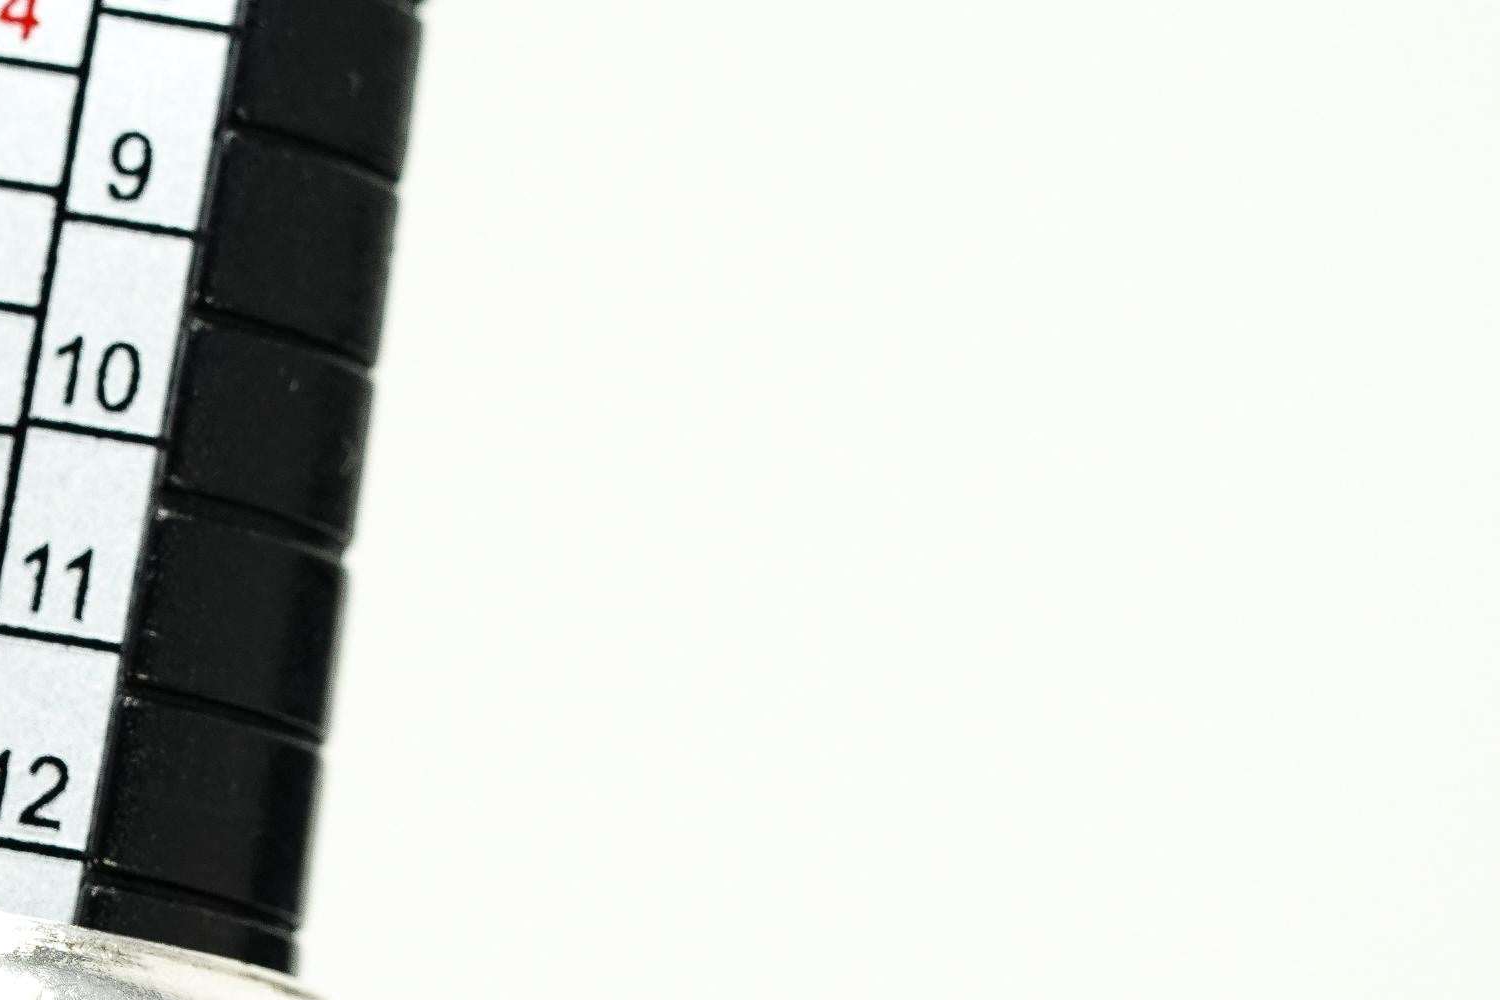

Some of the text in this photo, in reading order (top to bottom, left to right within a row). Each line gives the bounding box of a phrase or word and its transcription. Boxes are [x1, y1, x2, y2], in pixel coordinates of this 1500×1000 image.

[107, 131, 153, 202] 9
[56, 335, 141, 413] 10
[23, 543, 94, 621] 11
